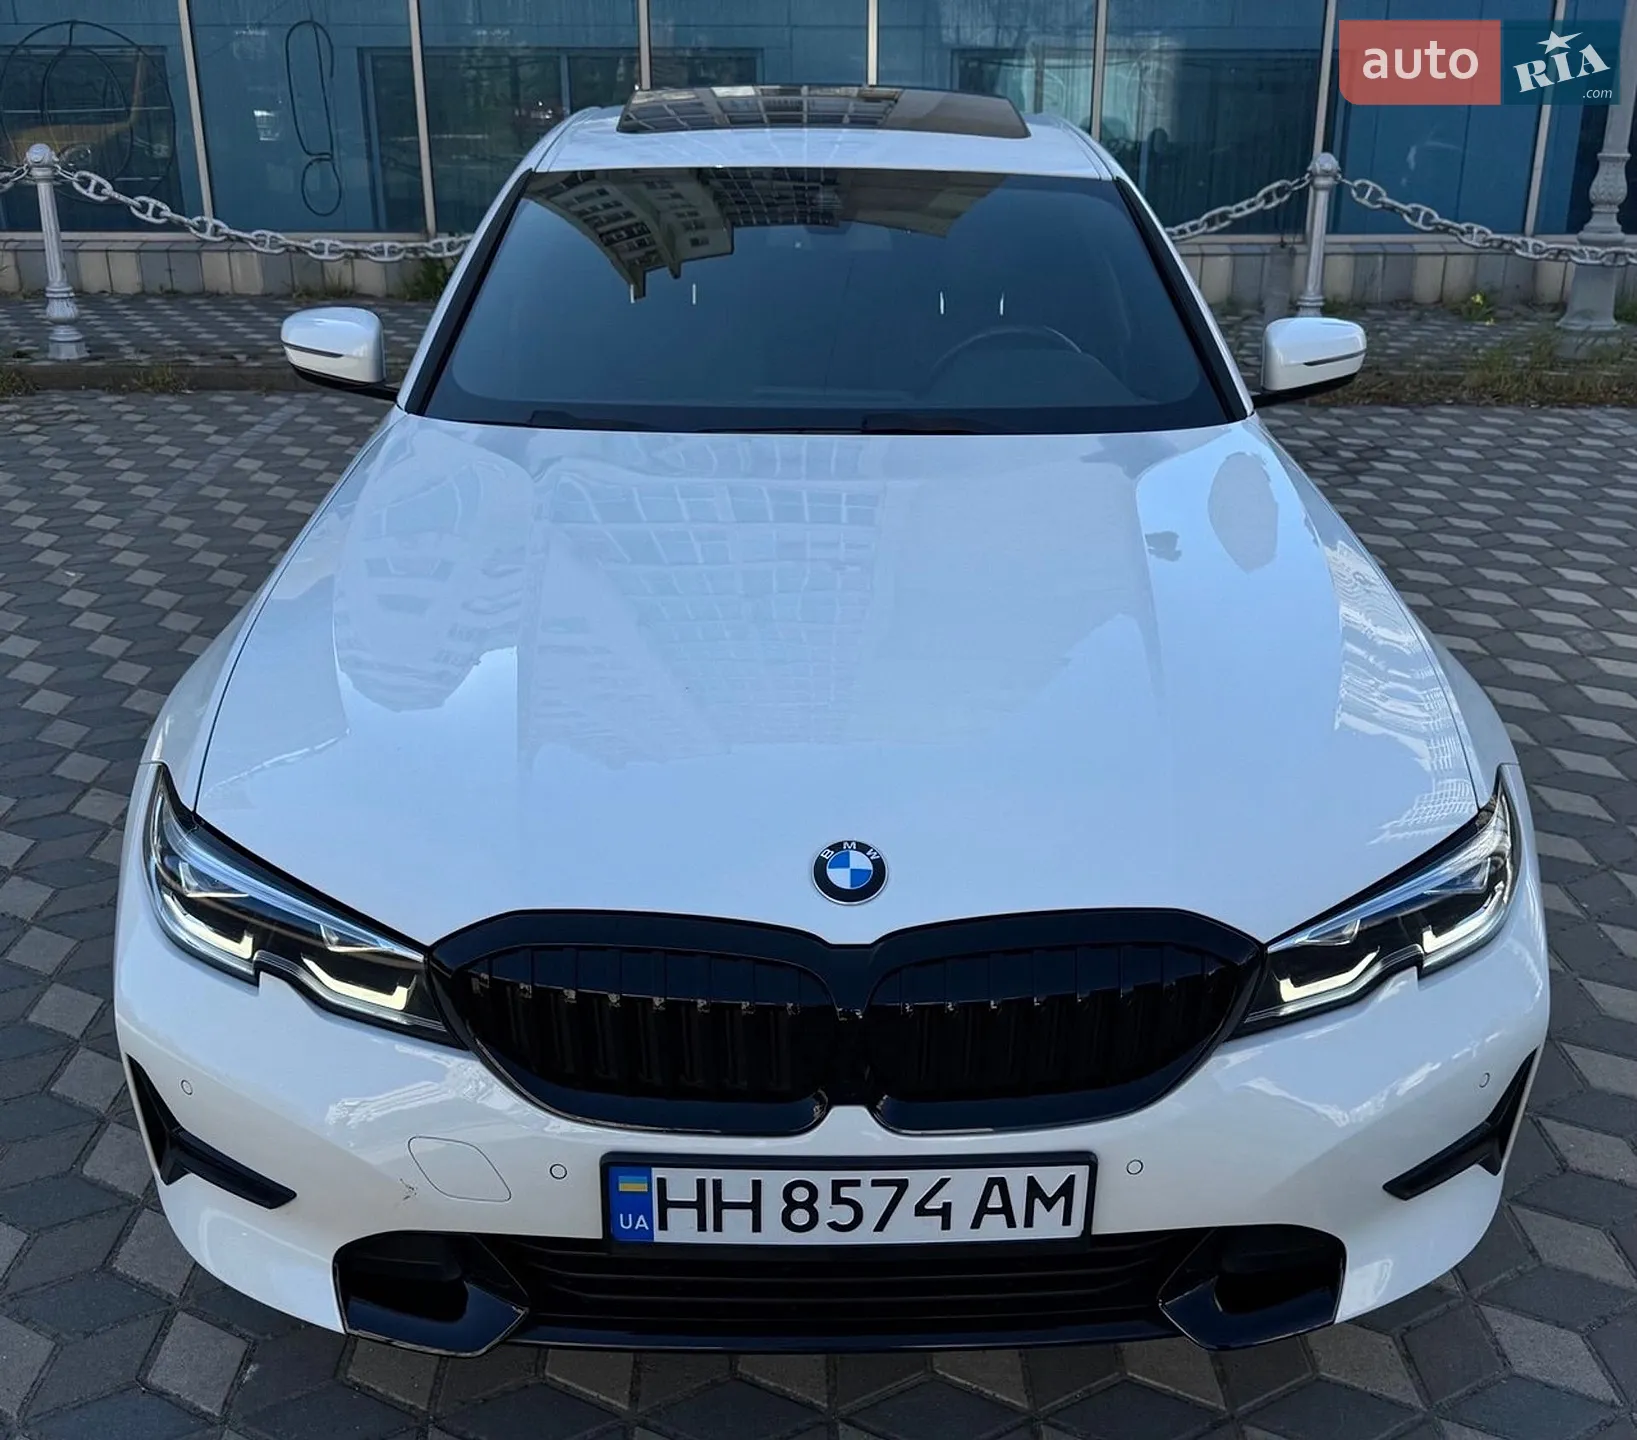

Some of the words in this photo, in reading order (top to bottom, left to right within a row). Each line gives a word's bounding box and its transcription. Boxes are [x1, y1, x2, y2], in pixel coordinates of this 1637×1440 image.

[820, 841, 880, 860] BMW
[656, 1177, 762, 1233] HH
[781, 1177, 952, 1233] 8574
[970, 1174, 1076, 1230] AM
[619, 1213, 650, 1230] UA
